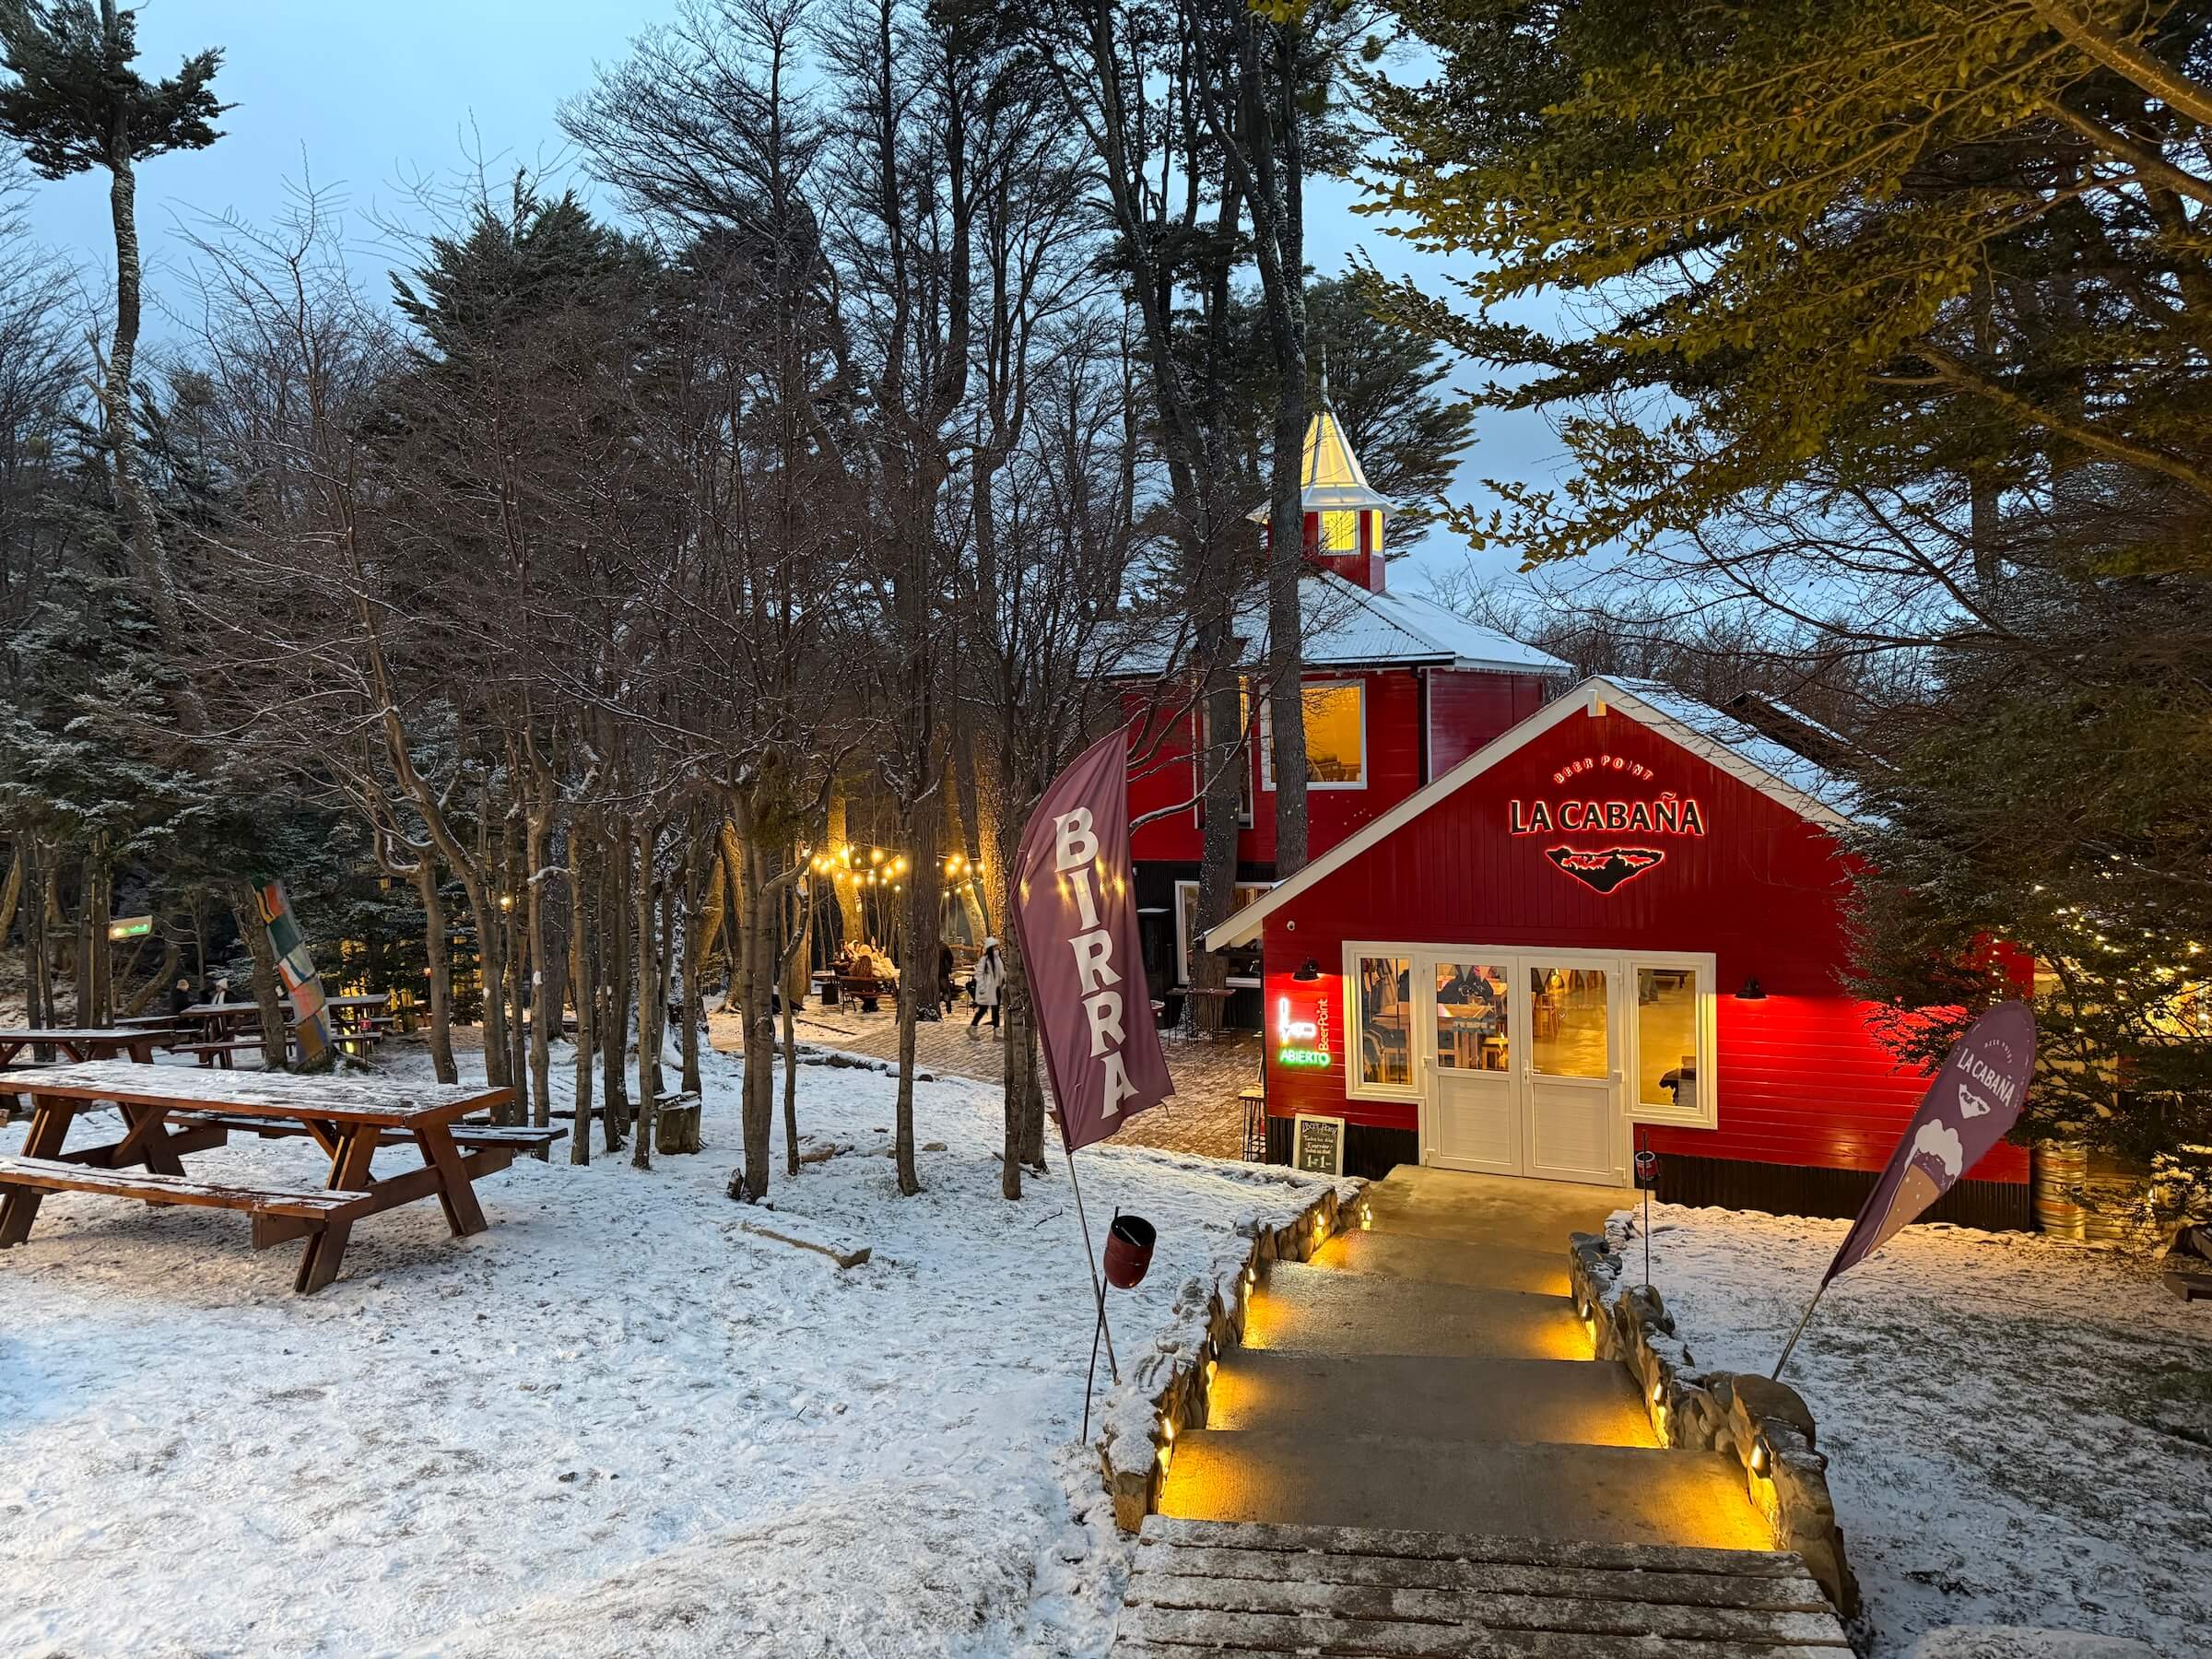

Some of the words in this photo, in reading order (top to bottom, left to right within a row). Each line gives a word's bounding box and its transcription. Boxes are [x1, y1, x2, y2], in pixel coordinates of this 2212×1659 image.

[1554, 758, 1594, 783] BEER
[1601, 755, 1654, 782] POINT
[1510, 800, 1554, 835] LA
[1559, 791, 1705, 836] CABAÑA
[1053, 806, 1139, 1120] BIRRA
[1280, 1049, 1331, 1066] ABIERTO
[1956, 1048, 1975, 1073] LA
[1971, 1060, 2016, 1107] CABAÑA
